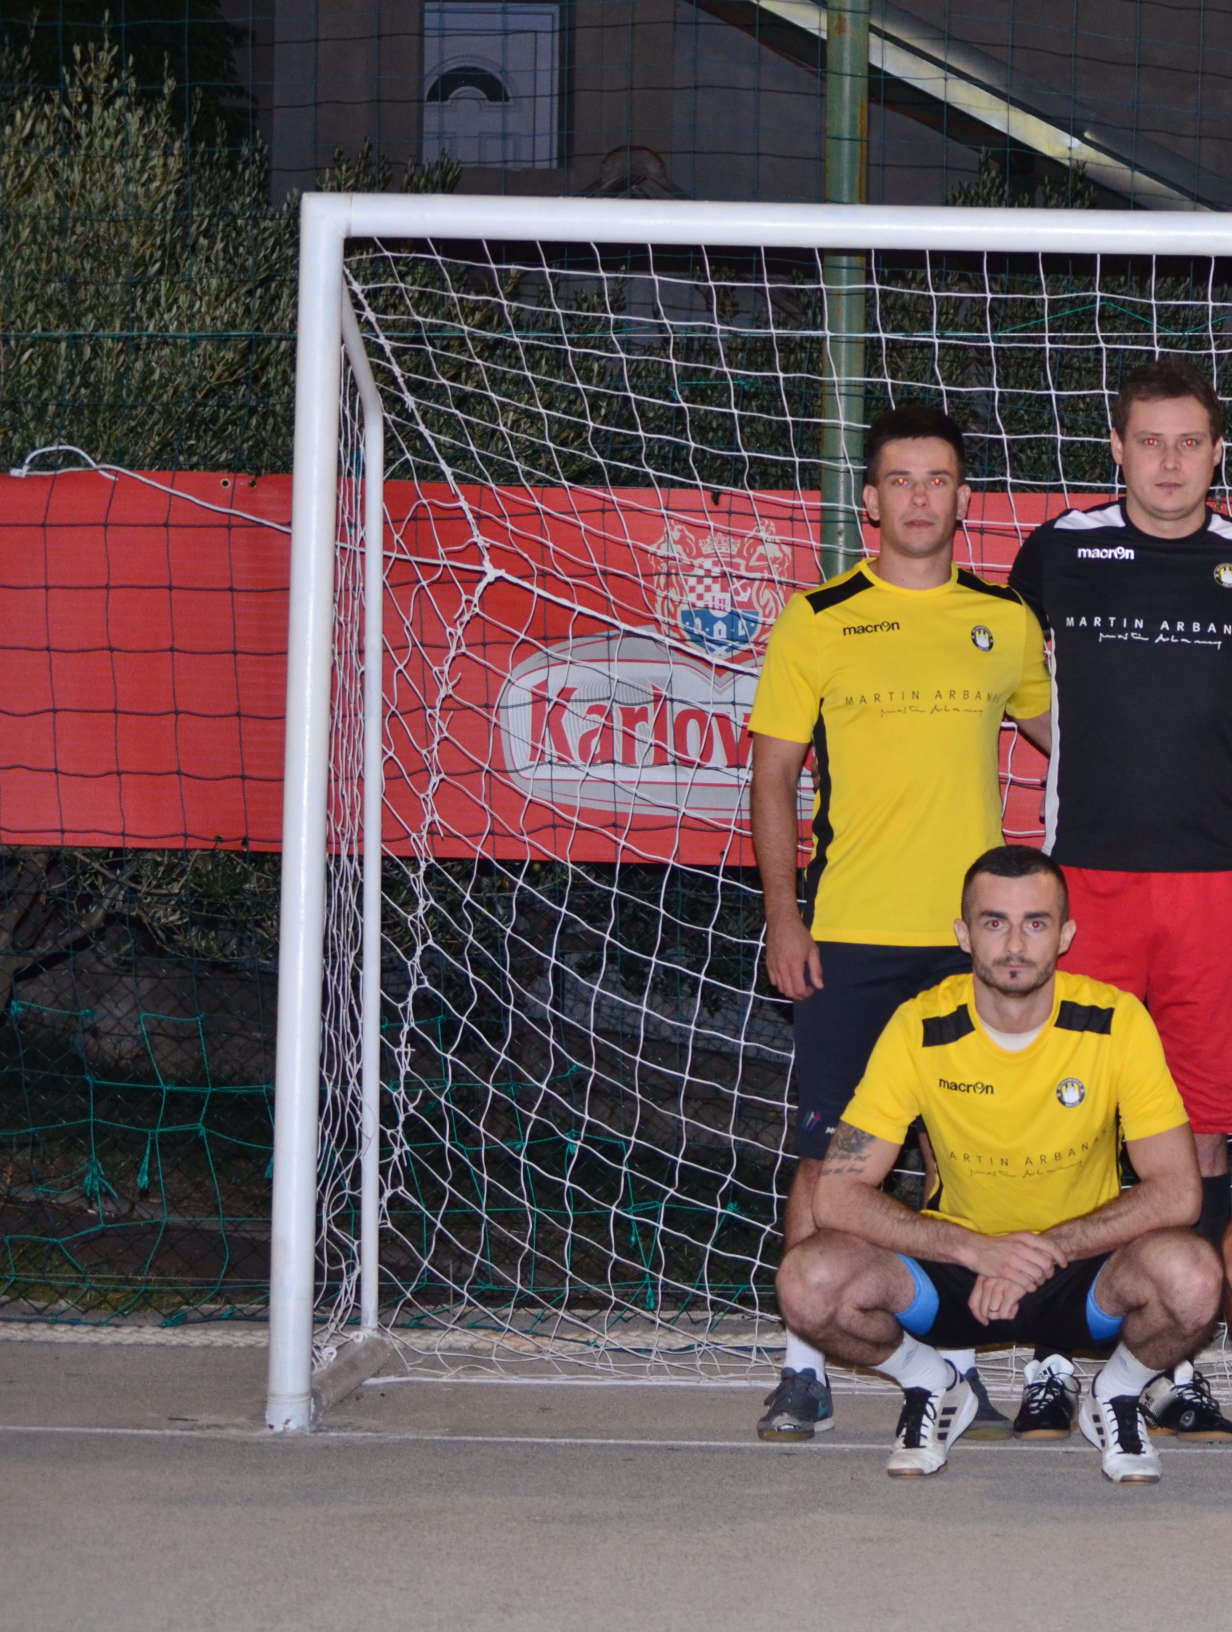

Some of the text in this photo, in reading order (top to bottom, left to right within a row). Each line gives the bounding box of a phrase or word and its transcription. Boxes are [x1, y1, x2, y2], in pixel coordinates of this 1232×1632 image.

[1077, 545, 1135, 560] macron
[842, 620, 901, 636] macron
[1065, 616, 1144, 630] MARTIN
[845, 689, 920, 706] MARTIN
[528, 679, 754, 768] Karlov
[938, 1078, 995, 1095] macron
[949, 1150, 1009, 1167] ARTIN
